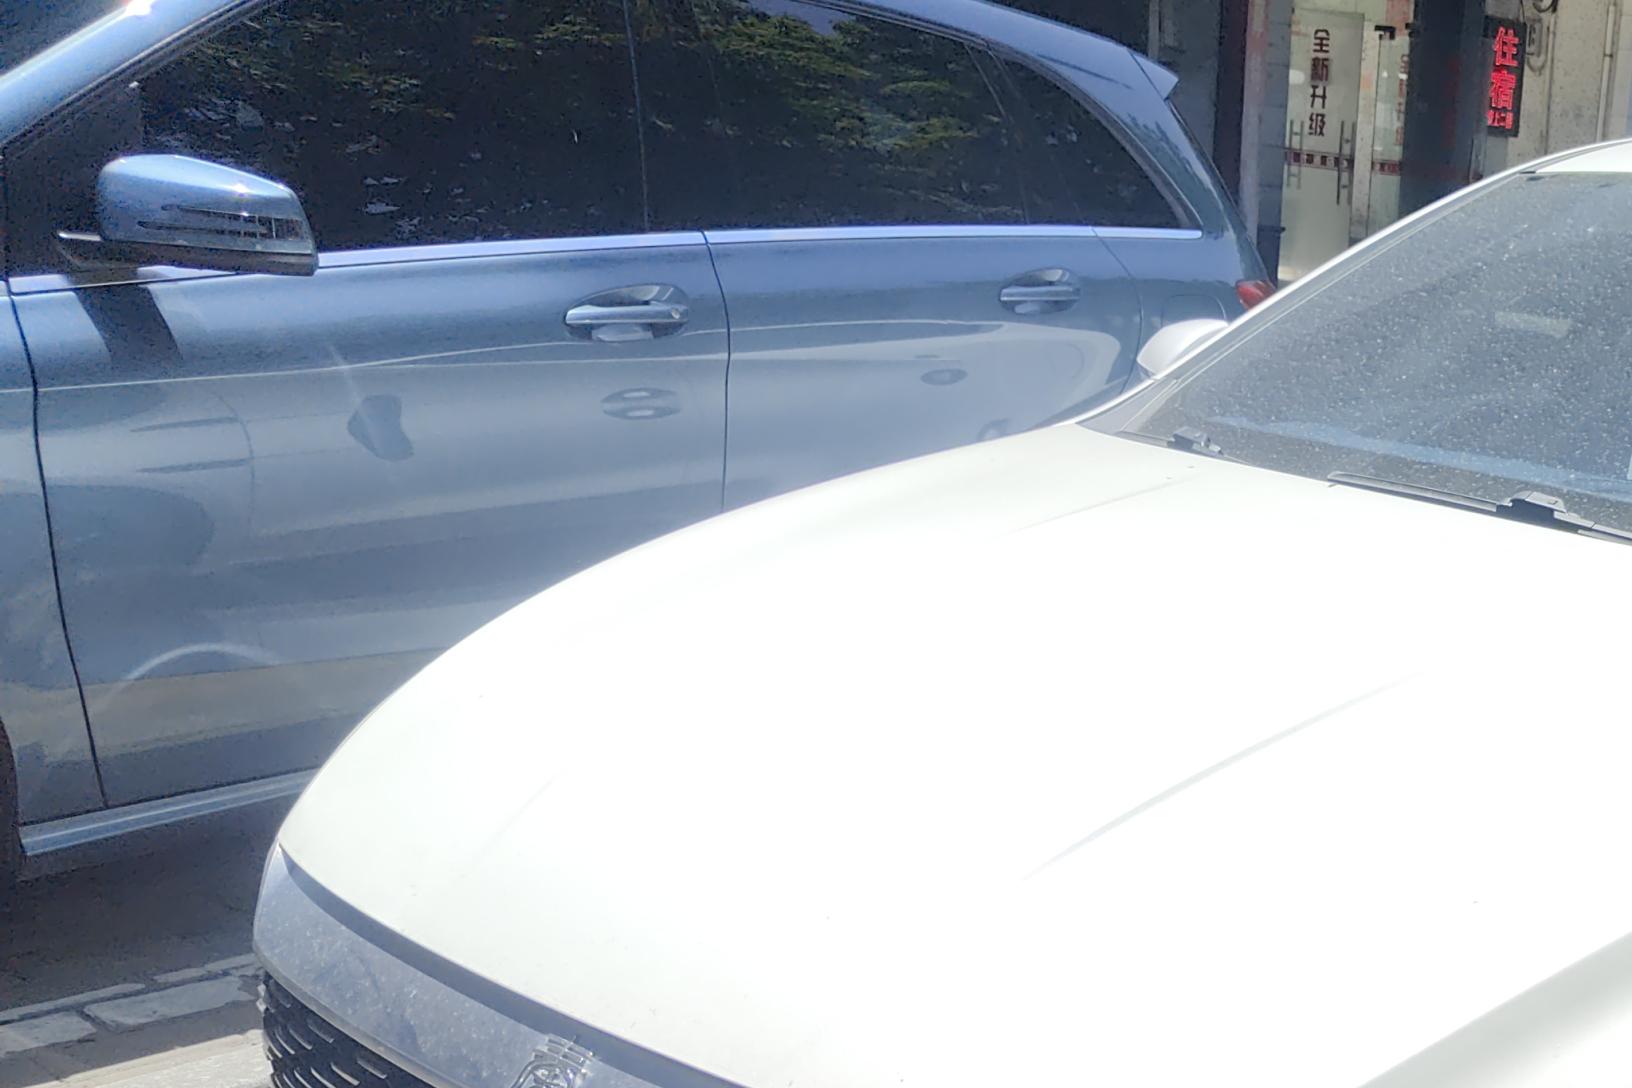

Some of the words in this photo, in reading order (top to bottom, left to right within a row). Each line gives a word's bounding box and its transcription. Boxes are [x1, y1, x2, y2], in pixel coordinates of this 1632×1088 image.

[1308, 29, 1330, 137] 全新升级
[1489, 26, 1519, 110] 住宿
